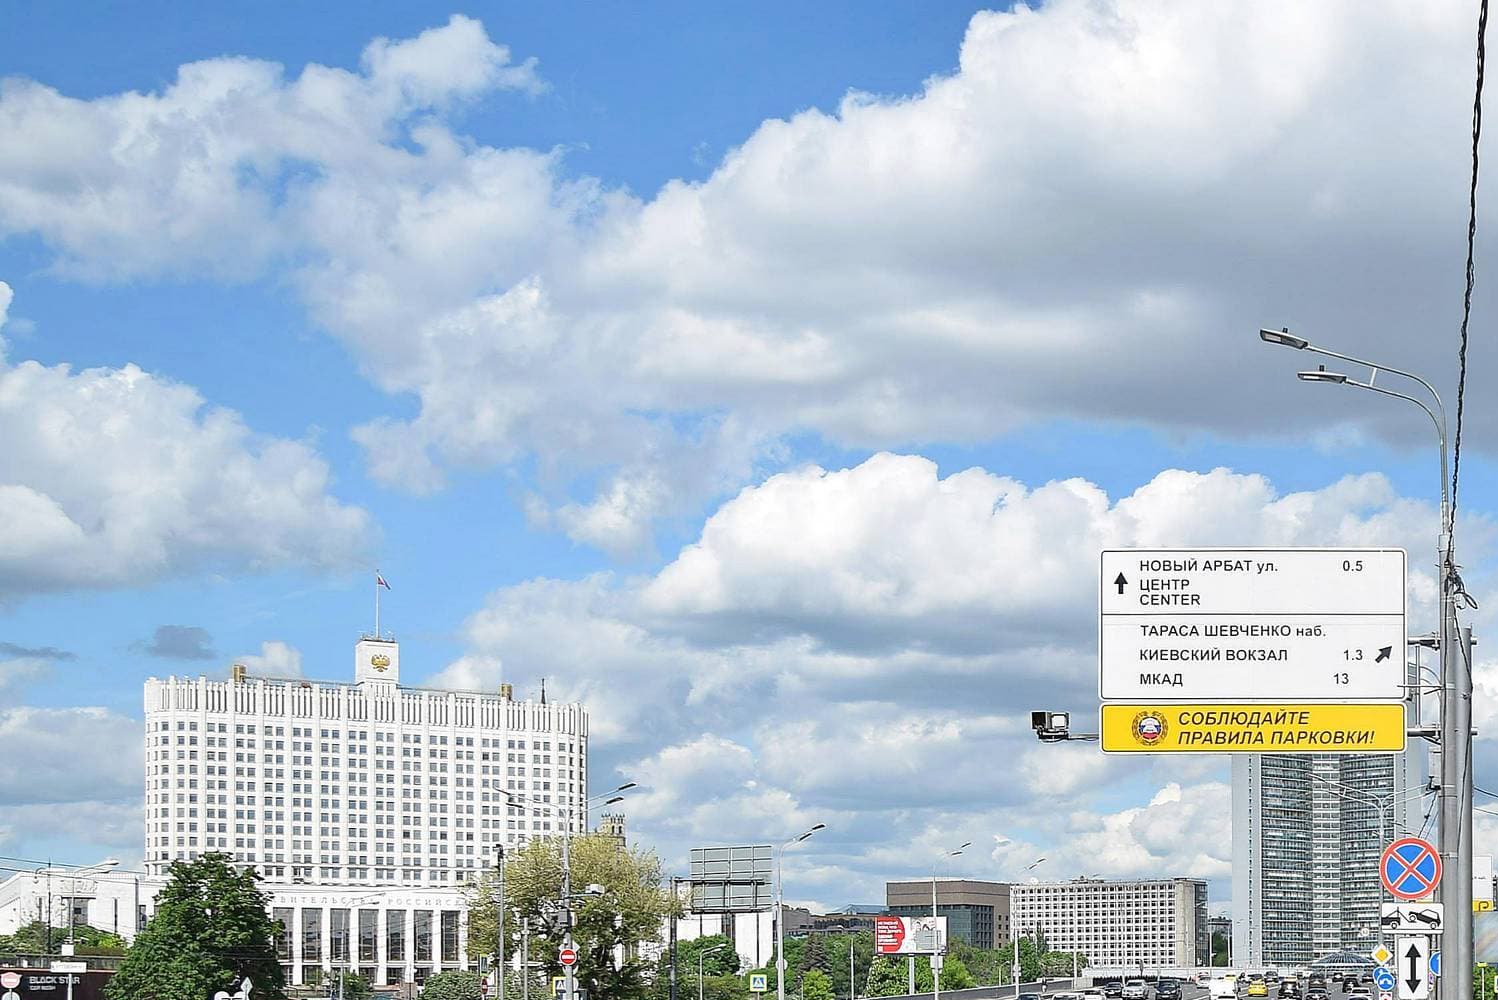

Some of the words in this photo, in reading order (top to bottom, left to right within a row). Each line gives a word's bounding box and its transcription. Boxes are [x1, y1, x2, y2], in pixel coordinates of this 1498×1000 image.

[1139, 558, 1198, 573] НОВЫЙ
[1202, 560, 1253, 573] АРБАТ
[1256, 563, 1278, 575] ул.
[1342, 560, 1364, 573] 0.5
[1139, 578, 1191, 593] ЦЕНТР
[1139, 594, 1201, 606] CENTER
[1140, 625, 1200, 637] ТАРАСА
[1204, 625, 1292, 637] ШЕВЧЕНКО
[1296, 625, 1327, 637] наб.
[1139, 647, 1222, 662] КИЕВСКИЙ
[1225, 649, 1289, 662] ВОКЗАЛ
[1343, 649, 1364, 662] 1.3
[1139, 673, 1184, 688] МКАД
[1333, 673, 1350, 686] 13
[1178, 709, 1310, 728] СОБЛЮДАЙТЕ
[1177, 731, 1266, 746] ПРАВИЛА
[1270, 731, 1376, 746] ПАРКОВКИ!
[29, 976, 58, 984] BLACK
[58, 976, 81, 984] STR
